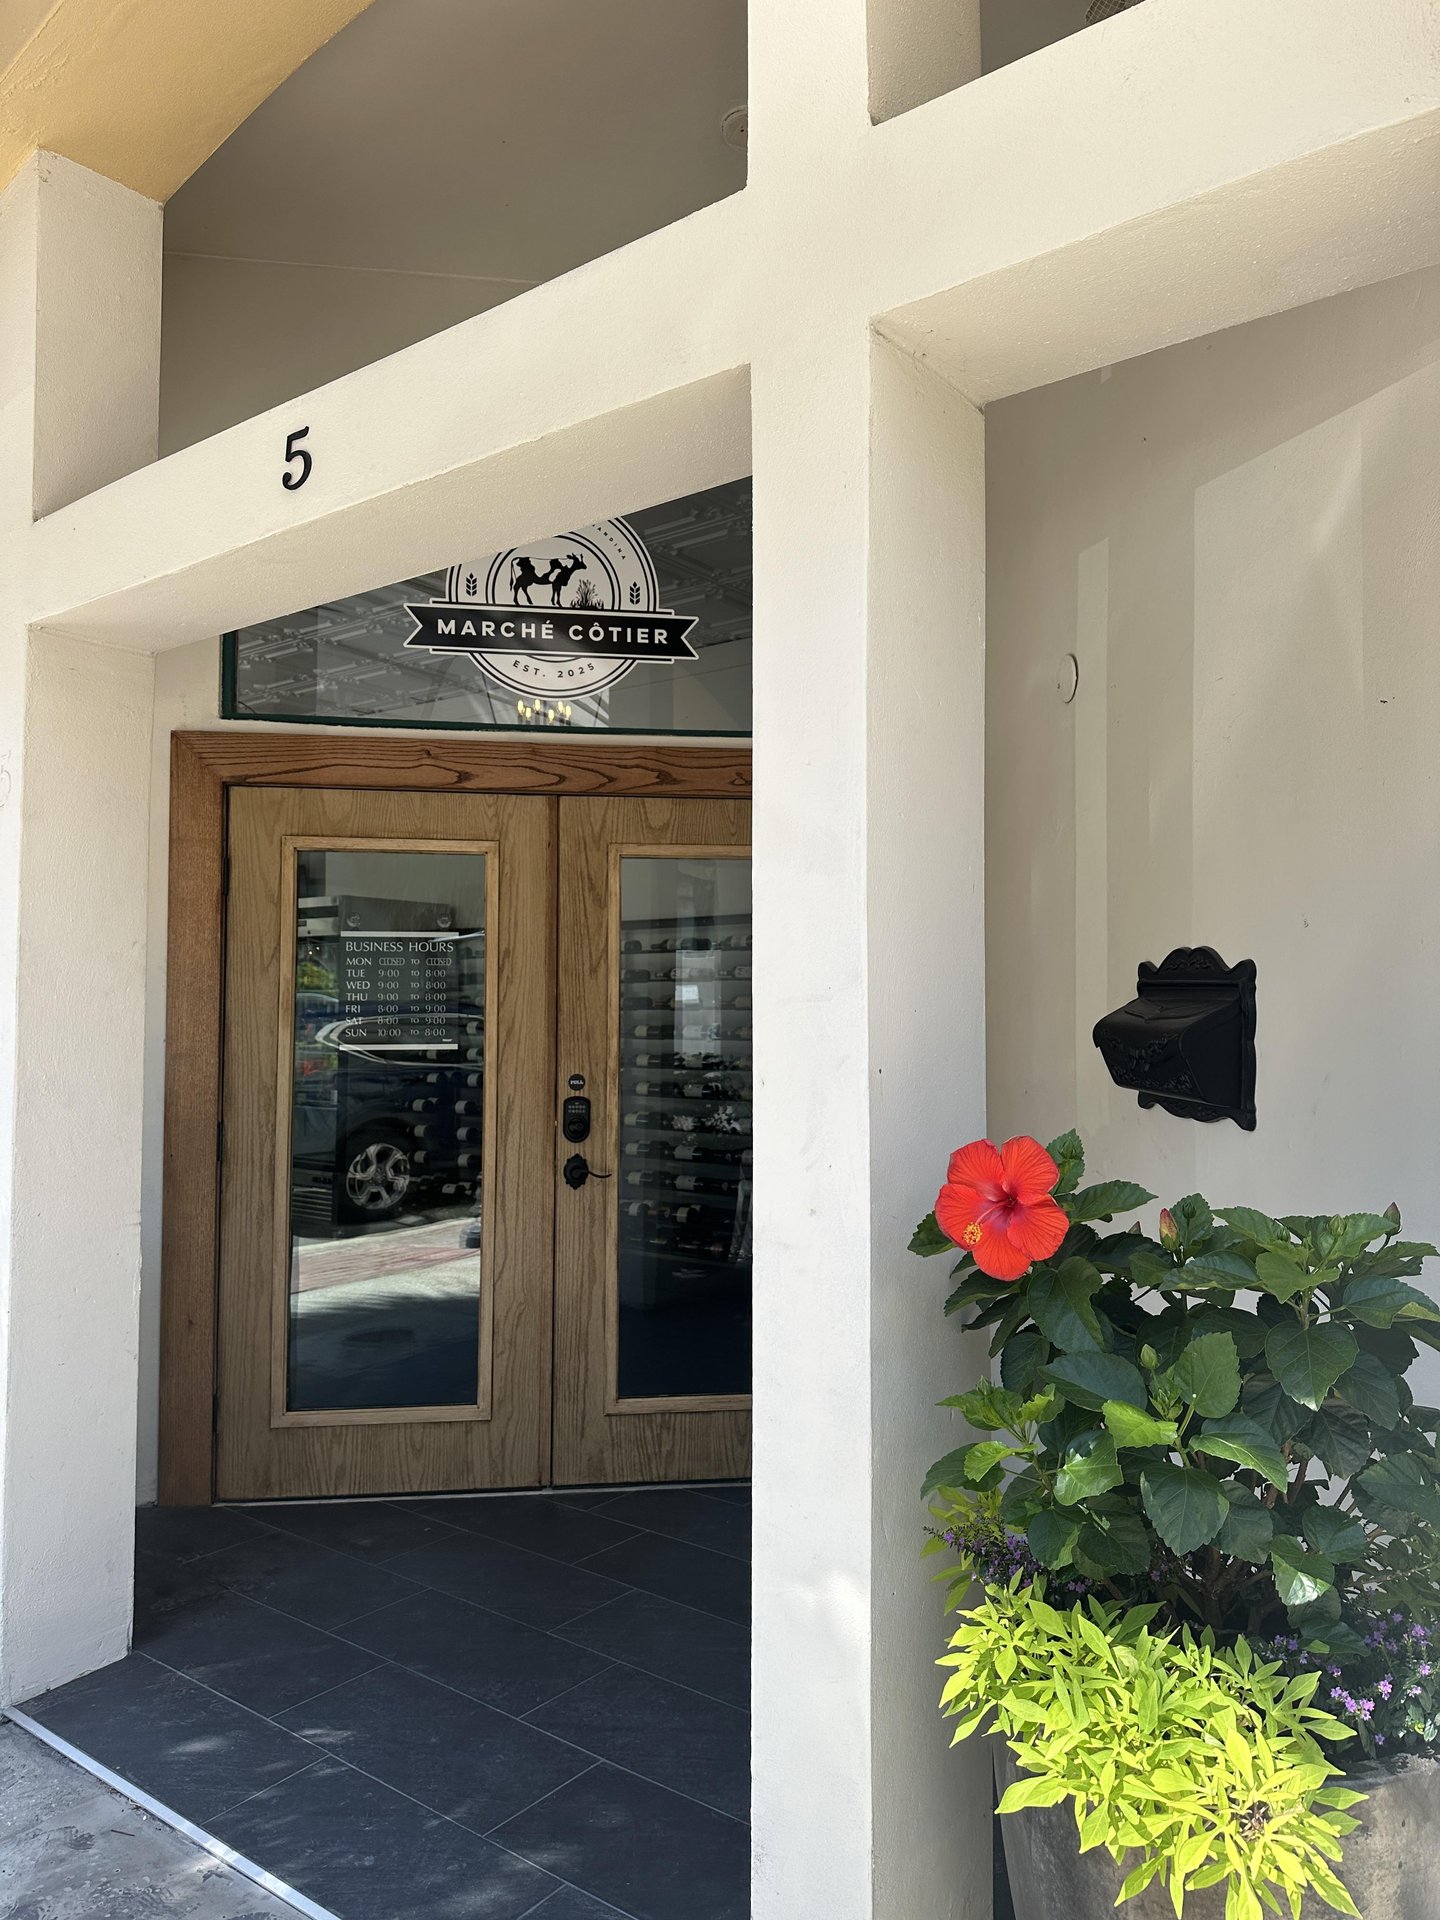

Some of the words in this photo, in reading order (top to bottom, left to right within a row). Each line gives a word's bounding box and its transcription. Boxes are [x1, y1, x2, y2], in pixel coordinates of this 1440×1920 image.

[282, 425, 312, 491] 5
[437, 618, 554, 640] MARCHÉ
[568, 622, 668, 645] CÔTIER
[512, 660, 546, 677] EST.
[557, 663, 595, 679] 2025
[345, 941, 404, 952] BUSINESS
[408, 941, 454, 953] HOURS
[346, 957, 372, 966] MON
[379, 957, 405, 966] CLOSED
[425, 957, 452, 966] CLOSED
[346, 969, 366, 978] TUE
[378, 969, 400, 978] 9:00
[425, 969, 446, 978] 8:00
[346, 981, 371, 989] WED
[378, 981, 399, 989] 9:00
[425, 981, 446, 989] 8:00
[346, 993, 368, 1001] THU
[377, 993, 399, 1001] 9:00
[425, 993, 447, 1001] 8:00
[345, 1005, 361, 1013] FRI
[377, 1005, 399, 1013] 8:00
[425, 1005, 446, 1013] 9:00
[345, 1017, 362, 1025] SAT
[377, 1017, 399, 1025] 8:00
[425, 1017, 446, 1025] 9:00
[345, 1029, 367, 1037] SUN
[378, 1029, 401, 1037] 10:00
[424, 1029, 446, 1037] 8:00
